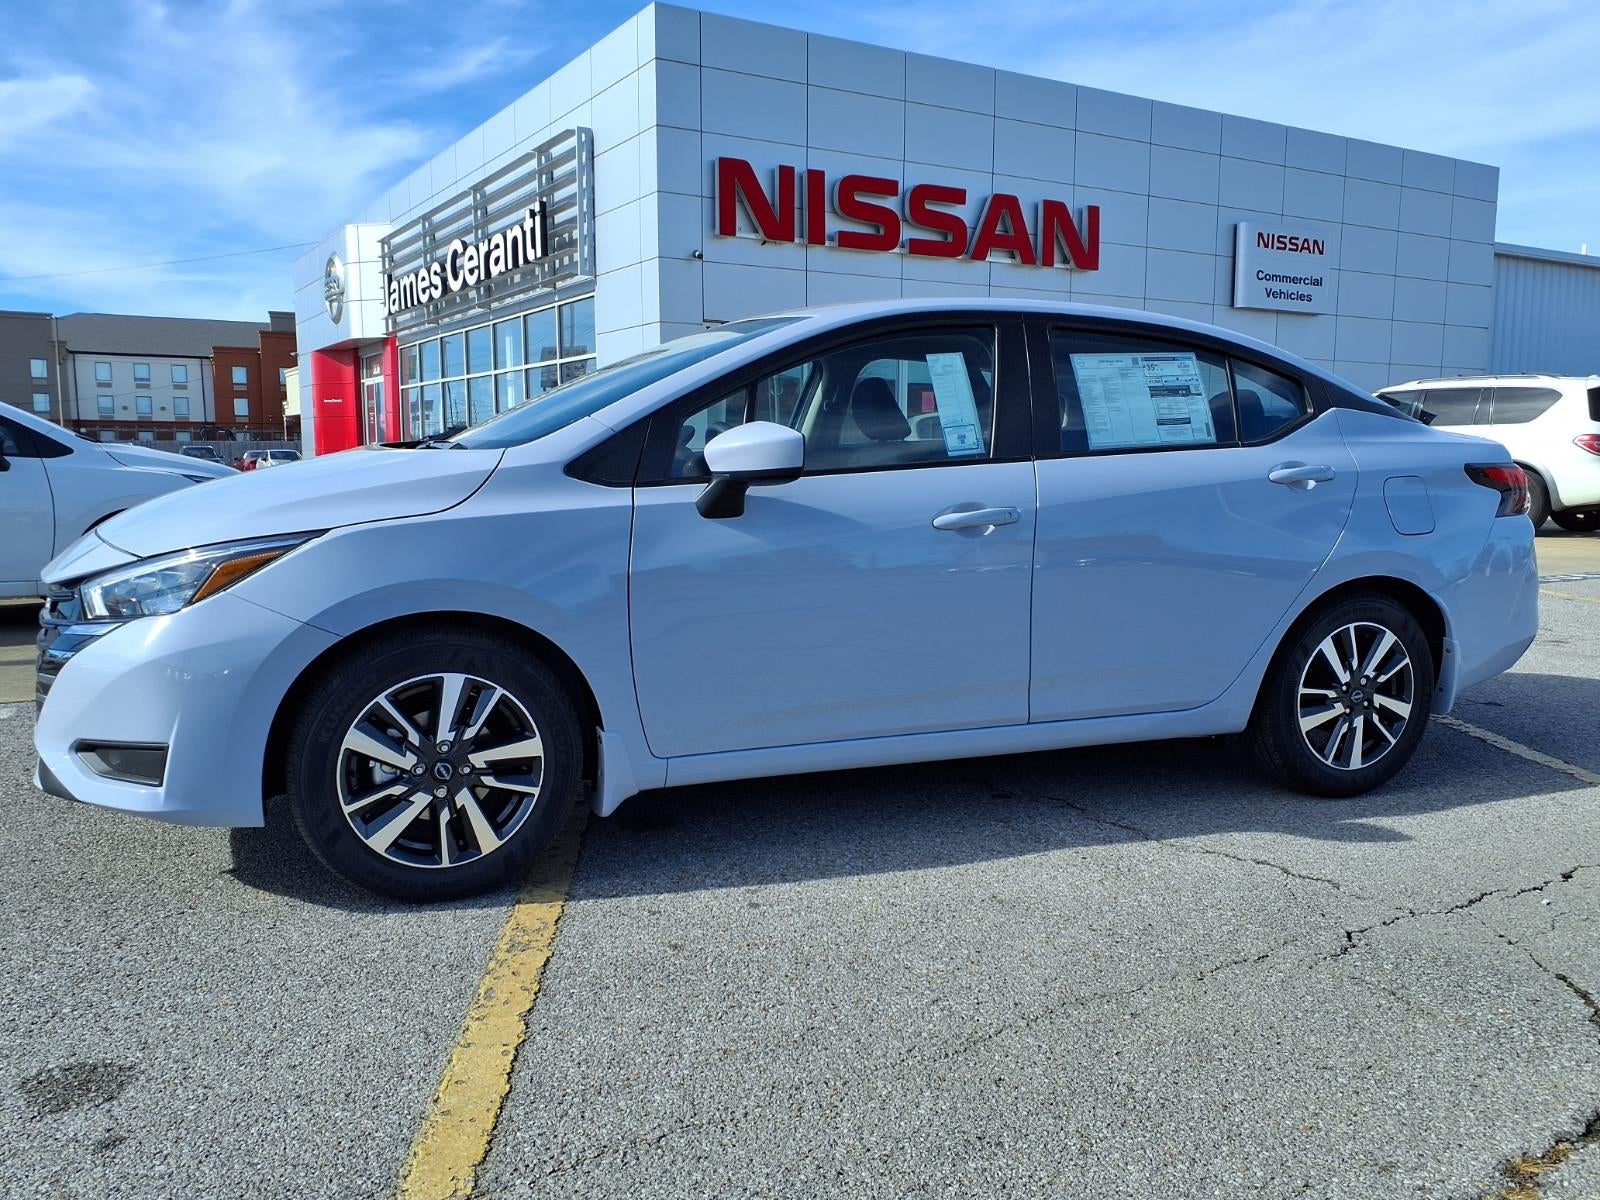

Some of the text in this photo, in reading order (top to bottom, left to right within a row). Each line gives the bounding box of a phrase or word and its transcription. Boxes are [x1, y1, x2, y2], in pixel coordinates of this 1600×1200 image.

[715, 156, 1101, 271] NISSAN
[1257, 232, 1324, 255] NISSAN
[383, 201, 543, 316] James Ceranti
[1256, 269, 1323, 287] Commercial
[1265, 287, 1312, 302] Vehicles
